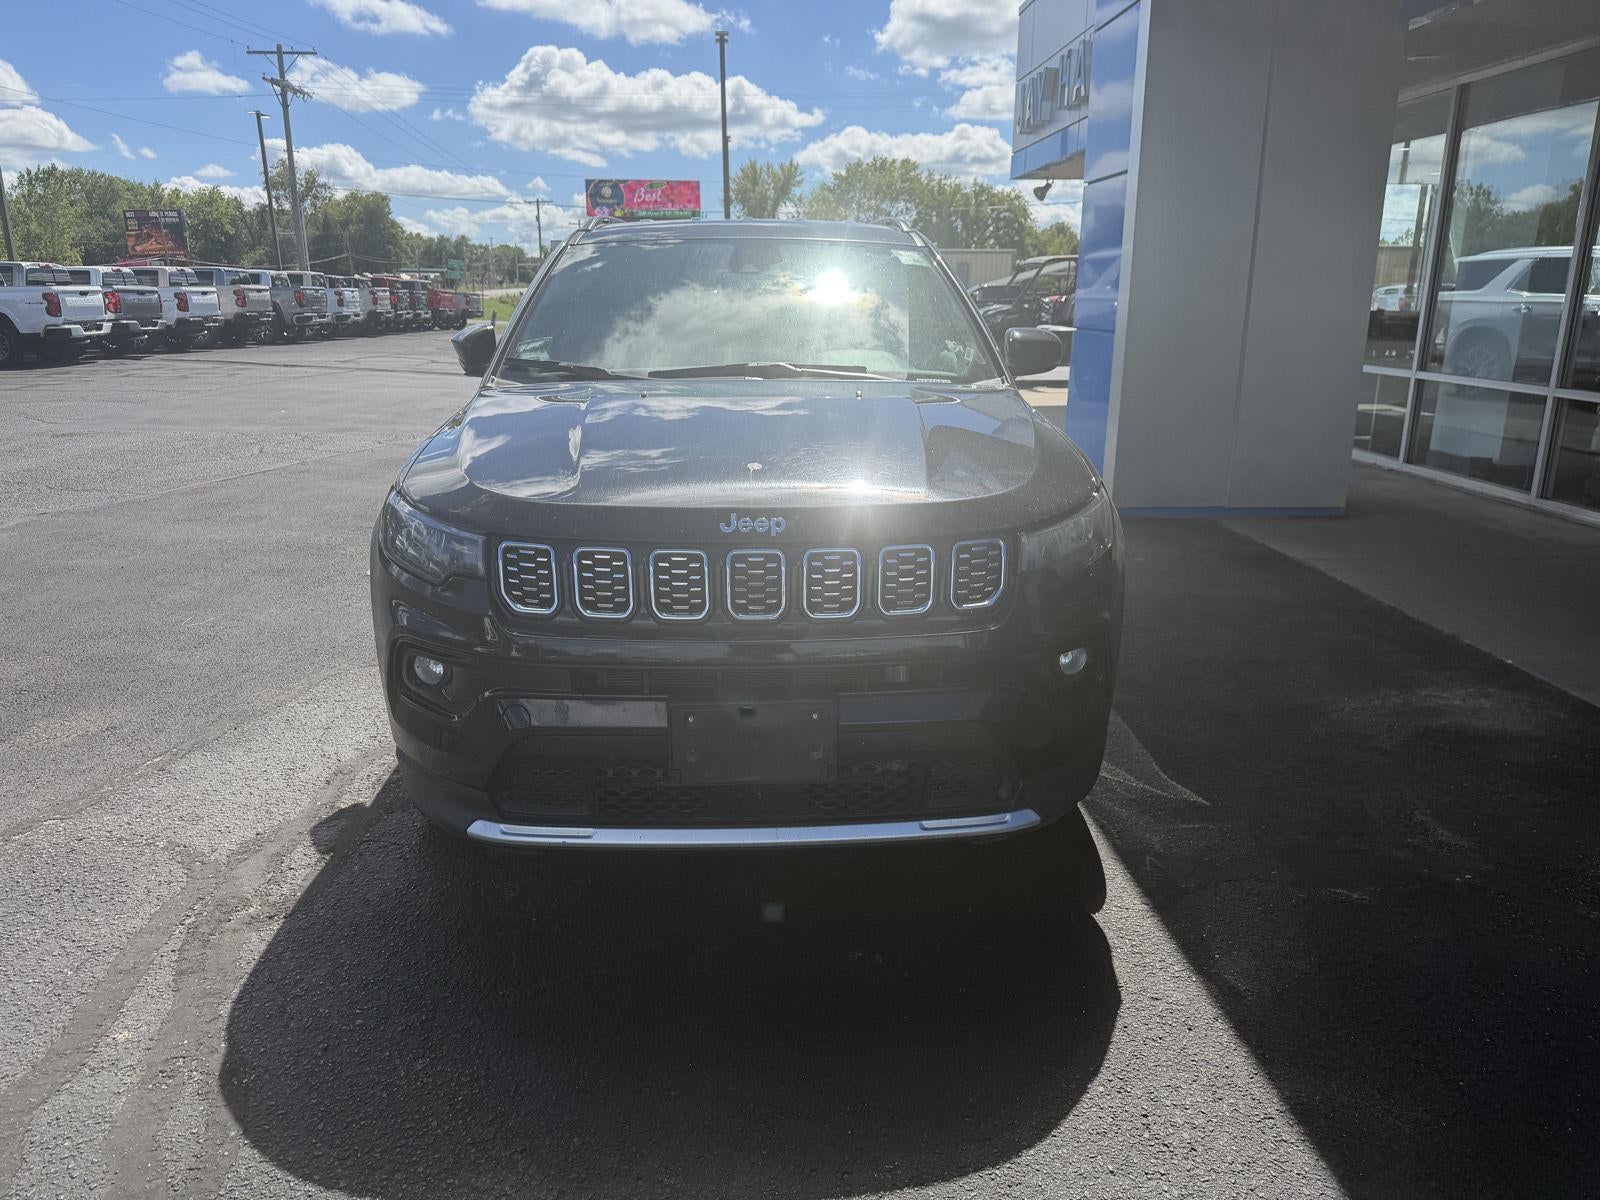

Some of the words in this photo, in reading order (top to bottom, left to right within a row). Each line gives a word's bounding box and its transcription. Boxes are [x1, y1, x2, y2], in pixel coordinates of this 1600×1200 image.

[1058, 34, 1092, 110] HA
[634, 188, 662, 203] Best
[720, 513, 786, 536] Jeep
